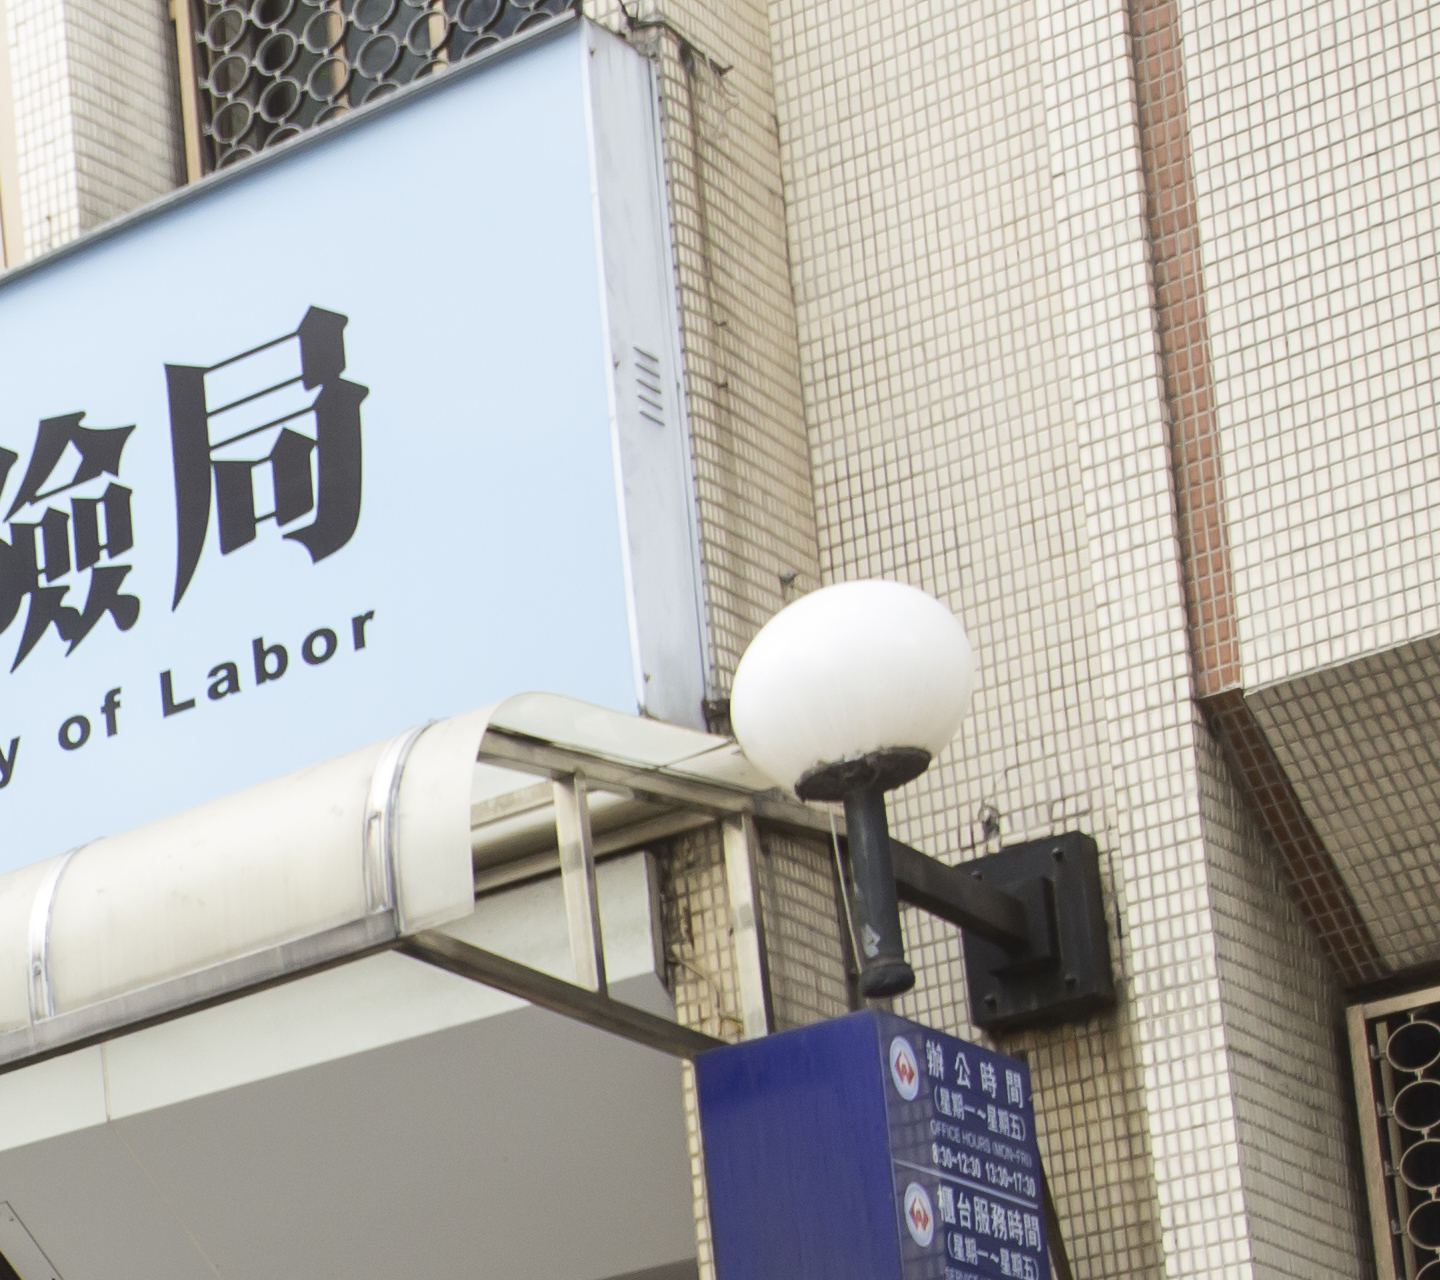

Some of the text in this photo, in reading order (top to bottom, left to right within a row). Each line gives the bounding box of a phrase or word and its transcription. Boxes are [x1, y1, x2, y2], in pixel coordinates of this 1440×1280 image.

[55, 685, 124, 752] of
[159, 609, 379, 728] Labor
[926, 1039, 1023, 1109] 辦公時間
[938, 1182, 1041, 1252] 櫃台服務時間
